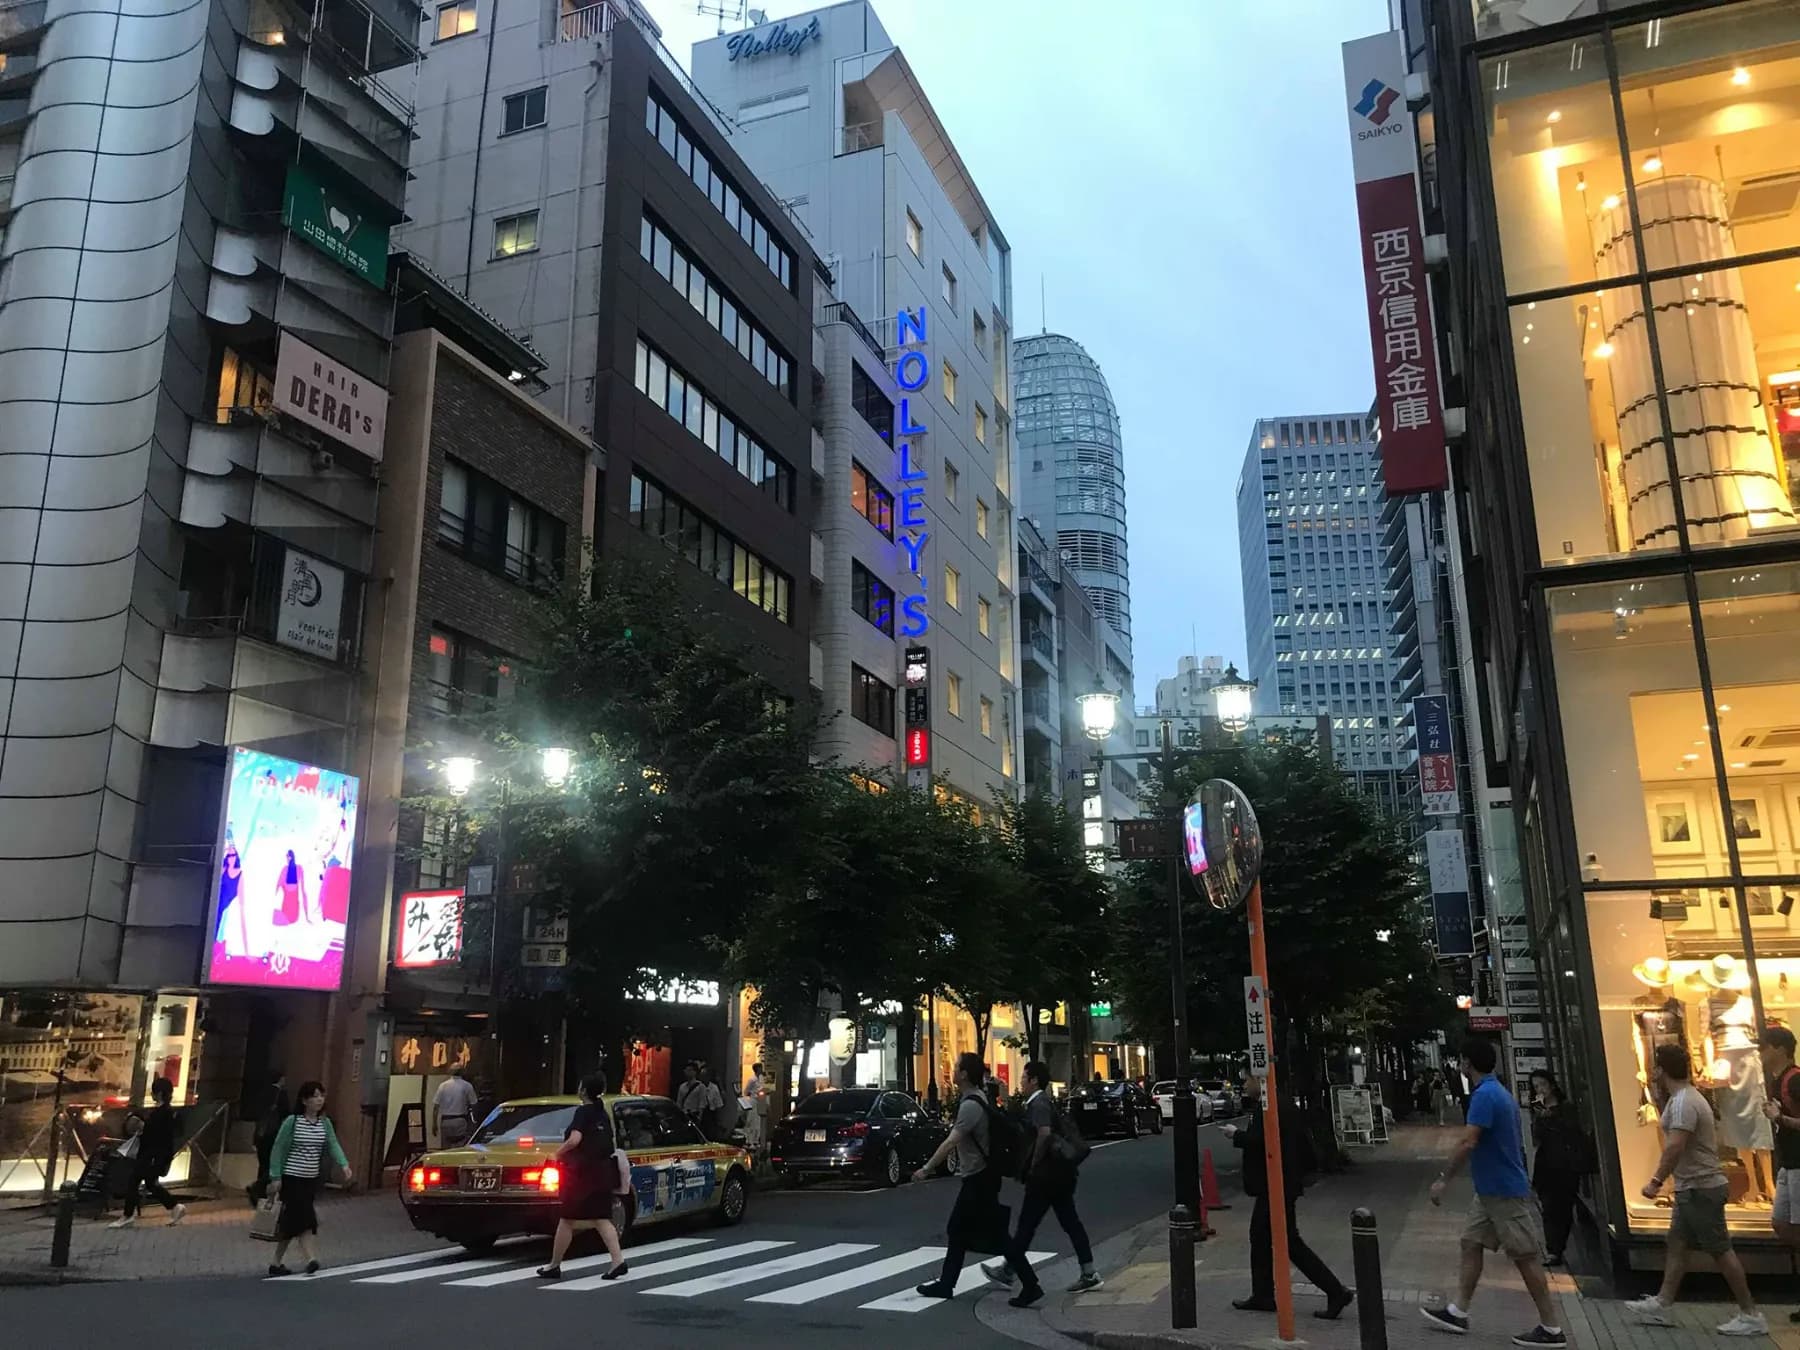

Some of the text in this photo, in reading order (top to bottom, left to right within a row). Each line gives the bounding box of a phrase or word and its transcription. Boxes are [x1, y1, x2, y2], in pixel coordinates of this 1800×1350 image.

[1357, 123, 1403, 141] SAIKYO
[303, 218, 369, 273] 山田歯科医院
[1371, 226, 1432, 432] 西京信用金庫
[313, 361, 359, 399] HAIR
[897, 306, 930, 638] NOLLEY'S
[1436, 754, 1454, 791] マース
[1248, 1011, 1266, 1068] 注意
